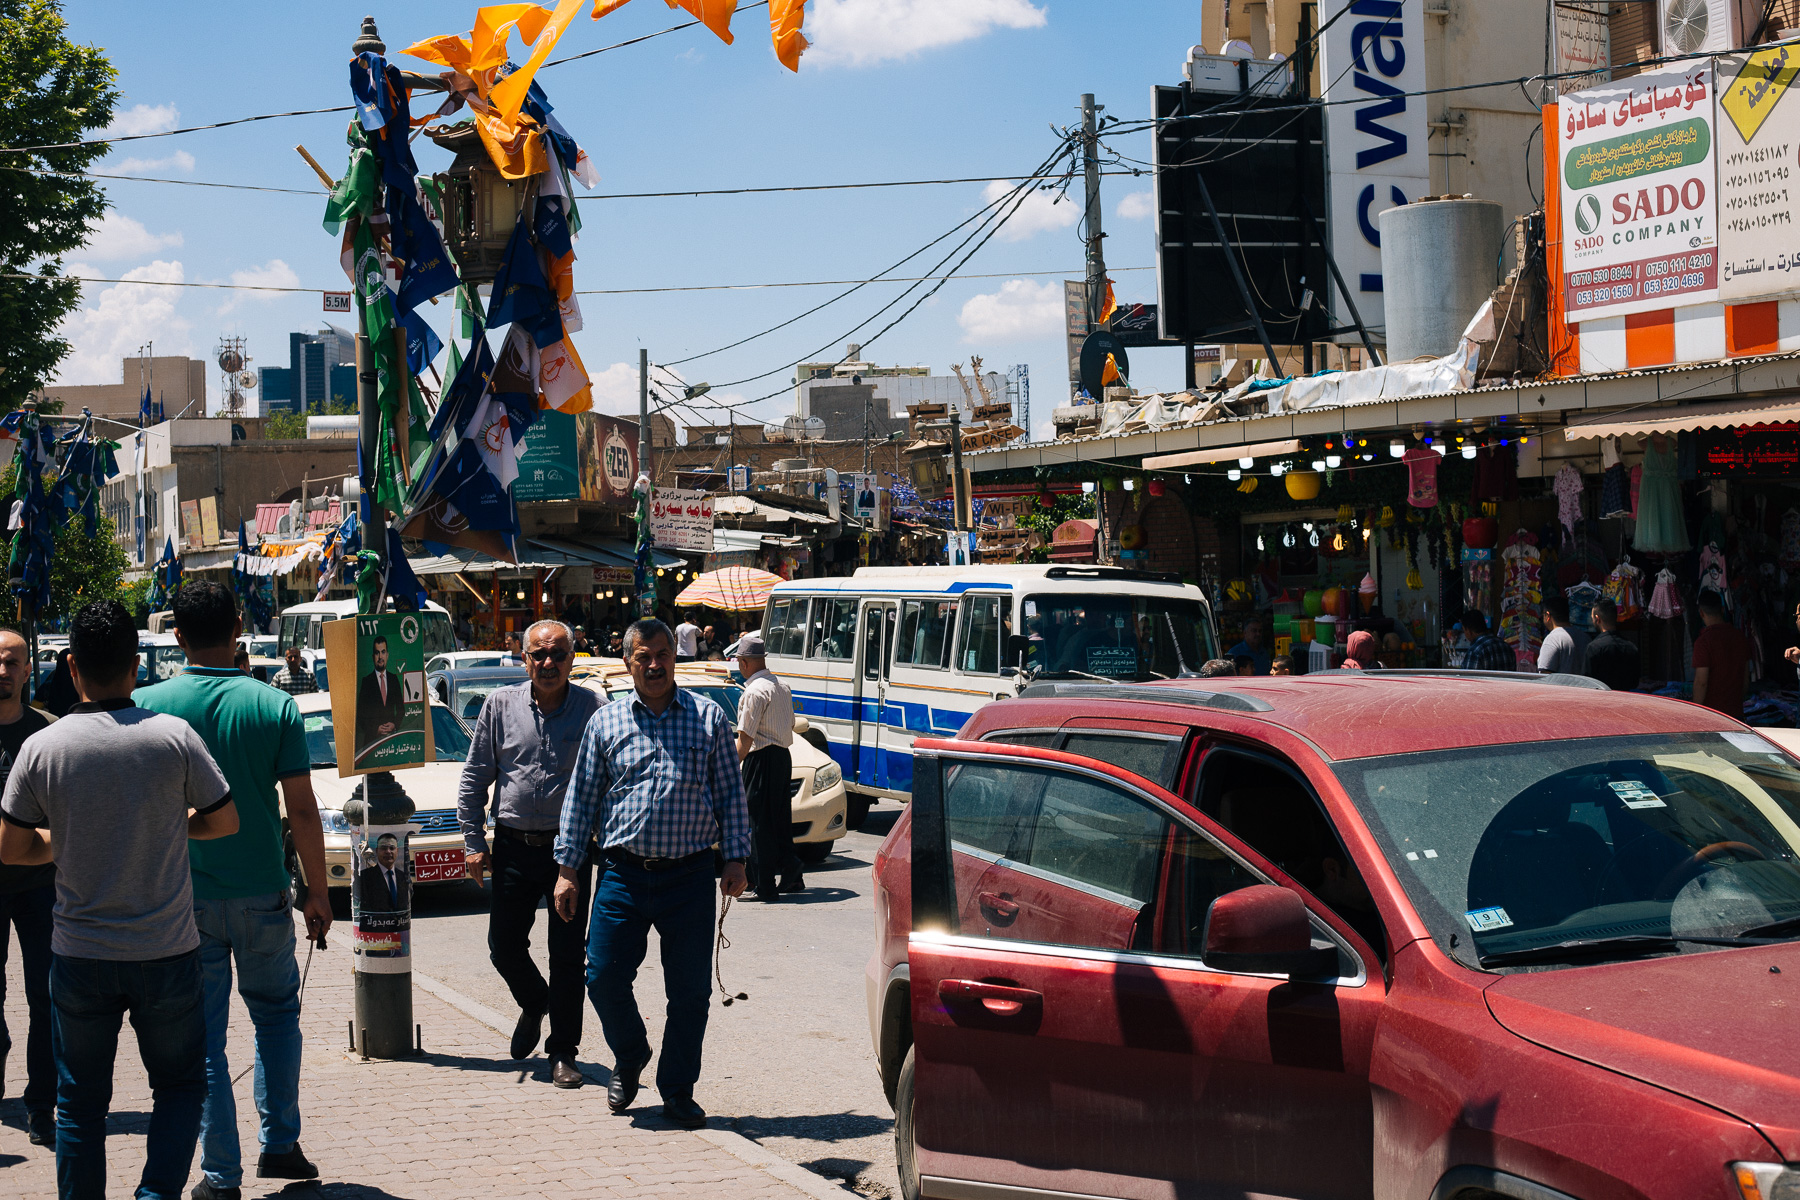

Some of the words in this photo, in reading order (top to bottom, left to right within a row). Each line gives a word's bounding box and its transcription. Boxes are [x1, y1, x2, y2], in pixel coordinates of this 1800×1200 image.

[1612, 177, 1706, 225] SADO
[1612, 216, 1704, 245] COMPANY
[1574, 235, 1604, 251] SADO
[1574, 249, 1604, 258] COMPANY
[1571, 272, 1591, 286] 0770
[1593, 269, 1609, 283] 530
[1611, 265, 1632, 280] 8844
[1646, 261, 1668, 276] 0750
[1670, 258, 1687, 273] 111
[1689, 254, 1712, 269] 4210
[1577, 291, 1593, 304] 053
[1594, 288, 1610, 301] 320
[1612, 284, 1633, 298] 1560
[1644, 280, 1661, 293] 053
[1663, 276, 1679, 290] 320
[1681, 273, 1704, 286] 4696
[325, 296, 349, 308] 5.5M
[1194, 350, 1220, 358] HOTEL
[527, 424, 547, 432] pital
[961, 437, 978, 450] AR
[982, 429, 1013, 446] CAFE
[610, 446, 630, 479] ZER
[360, 620, 379, 636] ١٦٢
[405, 678, 420, 701] ١٠
[424, 852, 456, 863] ٢٢٨٤٠
[444, 866, 463, 877] العراق
